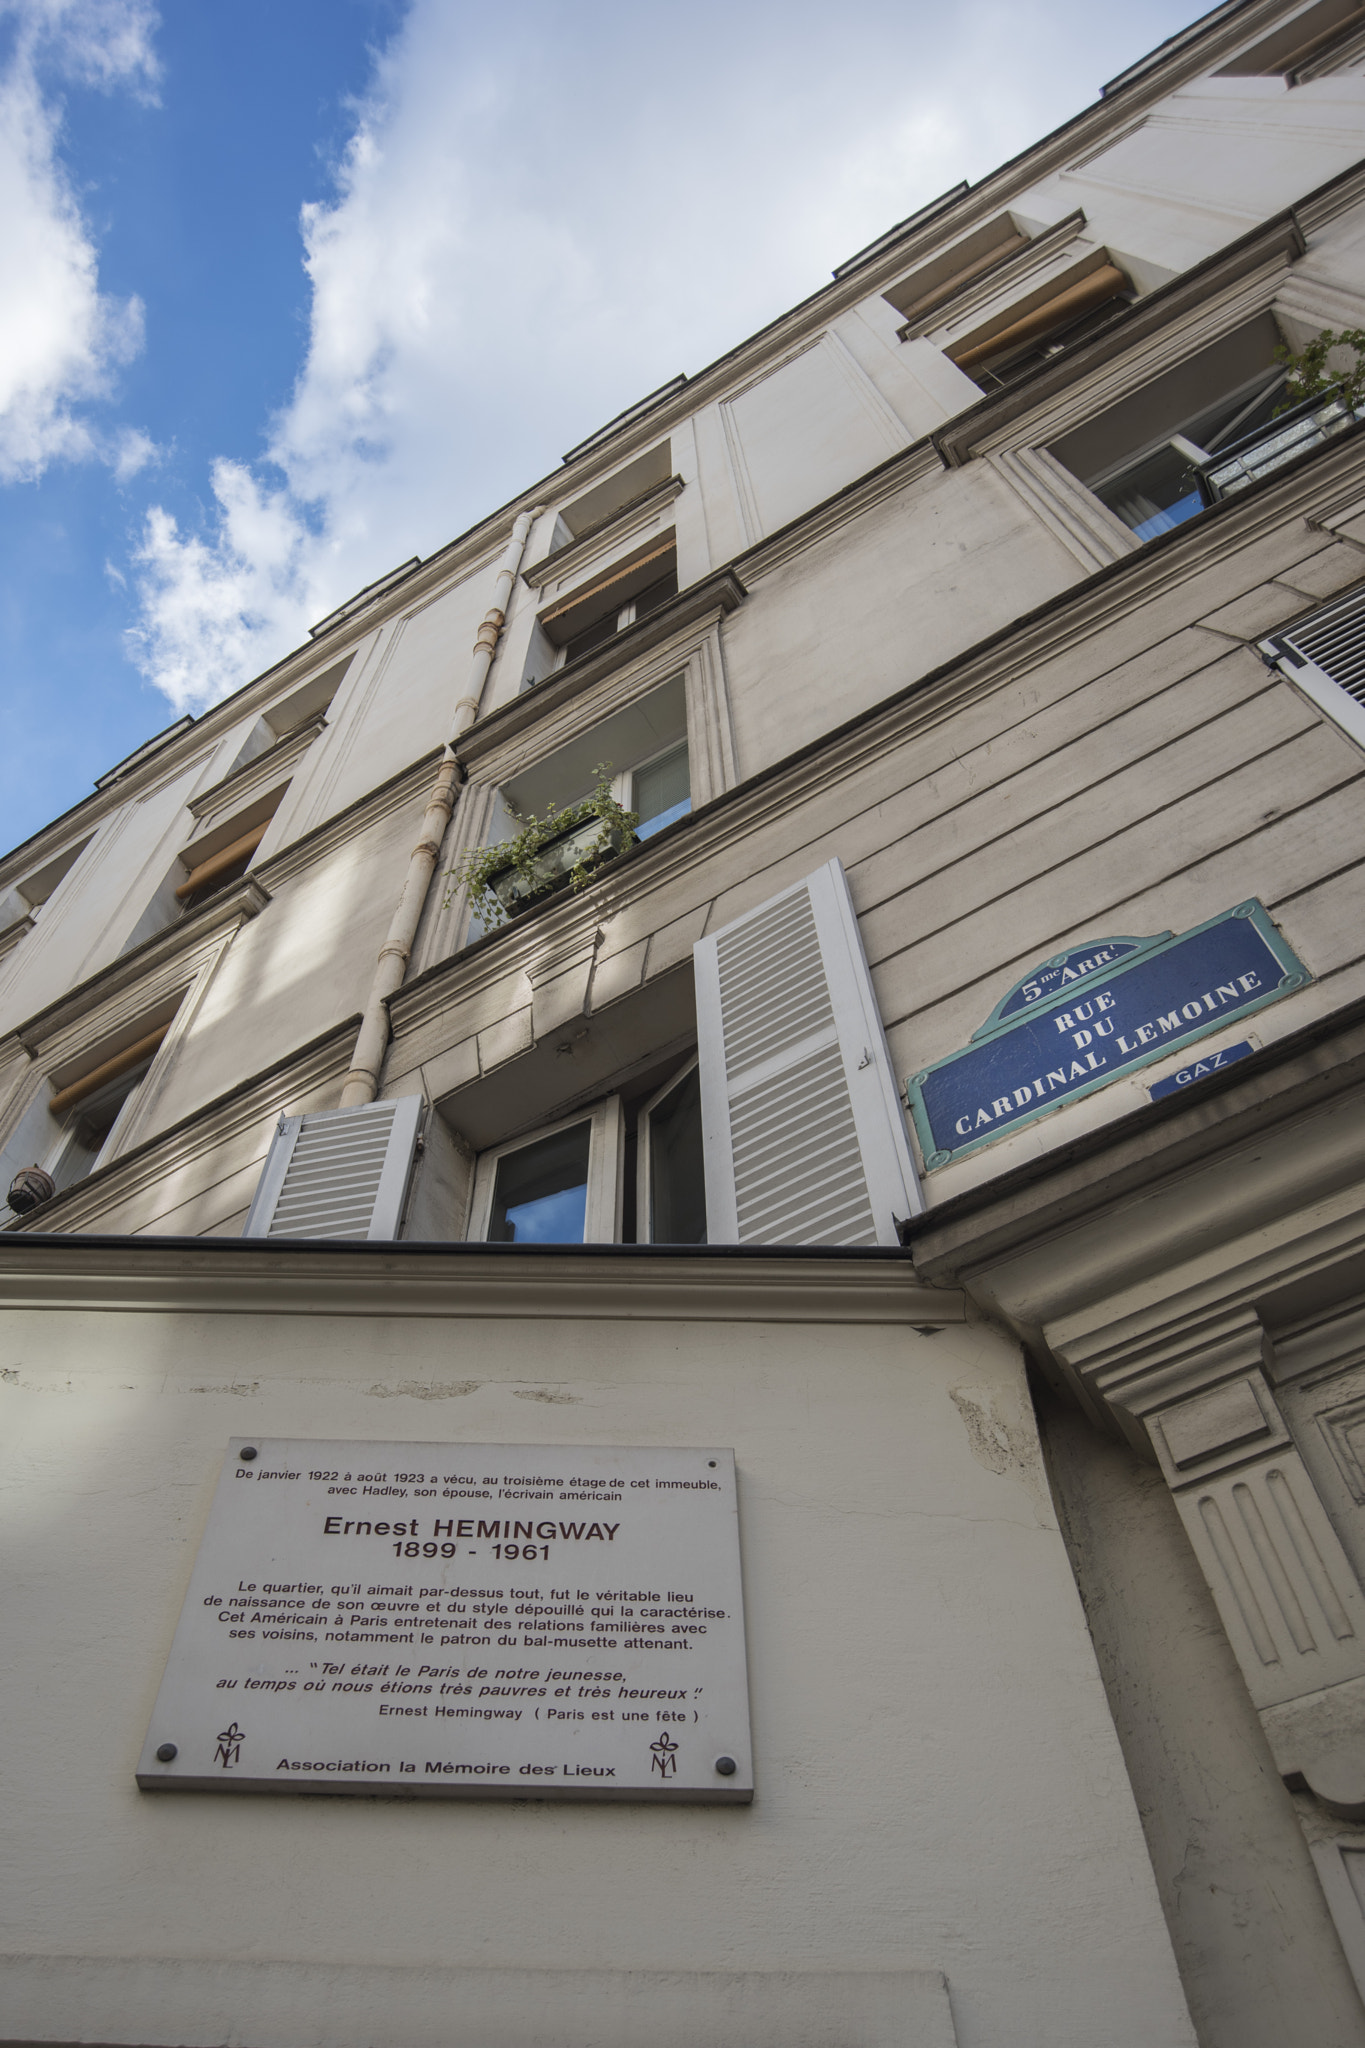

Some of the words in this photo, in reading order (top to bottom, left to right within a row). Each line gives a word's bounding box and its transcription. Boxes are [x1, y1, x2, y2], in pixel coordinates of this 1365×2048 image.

[1053, 991, 1116, 1034] RUE
[1072, 1016, 1115, 1050] DU
[955, 1051, 1107, 1135] CARDINAL
[1115, 970, 1262, 1055] LEMOINE
[1175, 1052, 1228, 1085] GAZ
[235, 1468, 254, 1479] De
[257, 1469, 302, 1481] janvier
[308, 1471, 339, 1481] 1922
[343, 1471, 352, 1482] à
[356, 1472, 388, 1483] août
[393, 1473, 425, 1484] 1923
[429, 1476, 438, 1484] a
[443, 1474, 477, 1486] vécu,
[482, 1477, 498, 1485] au
[503, 1475, 564, 1487] troisième
[569, 1477, 607, 1489] étage
[608, 1478, 625, 1488] de
[630, 1479, 650, 1488] cet
[655, 1478, 721, 1491] immeuble,
[327, 1486, 358, 1495] avec
[362, 1485, 408, 1498] Hadley,
[413, 1488, 437, 1497] son
[442, 1487, 493, 1500] épouse,
[498, 1488, 554, 1500] l'écrivain
[559, 1490, 622, 1501] américain
[323, 1516, 420, 1537] Ernest
[433, 1519, 621, 1541] HEMINGWAY
[392, 1541, 457, 1559] 1899
[491, 1543, 549, 1561] 1961
[238, 1580, 257, 1592] Le
[262, 1582, 324, 1596] quartier,
[331, 1583, 362, 1597] qu'il
[366, 1584, 414, 1596] aimait
[418, 1586, 504, 1599] par-dessus
[509, 1588, 544, 1602] tout,
[550, 1589, 570, 1600] fut
[576, 1589, 590, 1601] le
[595, 1589, 661, 1602] véritable
[667, 1591, 694, 1603] lieu
[203, 1595, 223, 1607] de
[228, 1596, 306, 1609] naissance
[311, 1598, 331, 1610] de
[336, 1601, 365, 1610] son
[370, 1601, 420, 1612] œuvre
[426, 1601, 441, 1613] et
[446, 1601, 467, 1613] du
[472, 1602, 509, 1616] style
[514, 1603, 585, 1617] dépouillé
[590, 1605, 614, 1619] qui
[620, 1605, 634, 1617] la
[640, 1607, 731, 1619] caractérise.
[218, 1610, 246, 1623] Cet
[250, 1612, 328, 1625] Américain
[334, 1614, 344, 1626] à
[350, 1614, 388, 1627] Paris
[394, 1616, 478, 1629] entretenait
[483, 1618, 512, 1630] des
[518, 1619, 585, 1632] relations
[590, 1620, 665, 1634] familières
[671, 1624, 707, 1634] avec
[228, 1629, 256, 1639] ses
[262, 1628, 318, 1643] voisins,
[325, 1630, 415, 1643] notamment
[420, 1632, 434, 1644] le
[440, 1633, 491, 1647] patron
[497, 1634, 517, 1646] du
[523, 1634, 617, 1648] bal-musette
[623, 1637, 693, 1650] attenant.
[350, 1663, 390, 1676] était
[395, 1664, 411, 1677] le
[417, 1665, 460, 1678] Paris
[466, 1666, 488, 1679] de
[494, 1668, 540, 1680] notre
[544, 1668, 626, 1683] jeunesse,
[216, 1679, 238, 1689] au
[244, 1677, 297, 1693] temps
[303, 1679, 326, 1691] où
[331, 1682, 374, 1693] nous
[380, 1681, 433, 1694] étions
[439, 1682, 473, 1697] très
[478, 1686, 547, 1698] pauvres
[554, 1685, 572, 1698] et
[578, 1685, 611, 1698] très
[379, 1704, 428, 1717] Ernest
[435, 1705, 523, 1721] Hemingway
[547, 1708, 585, 1720] Paris
[591, 1710, 615, 1721] est
[622, 1712, 650, 1722] une
[655, 1710, 686, 1722] fête
[276, 1758, 391, 1772] Association
[399, 1761, 416, 1773] la
[425, 1761, 511, 1775] Mémoire
[519, 1763, 555, 1776] des
[563, 1764, 616, 1777] Lieux
